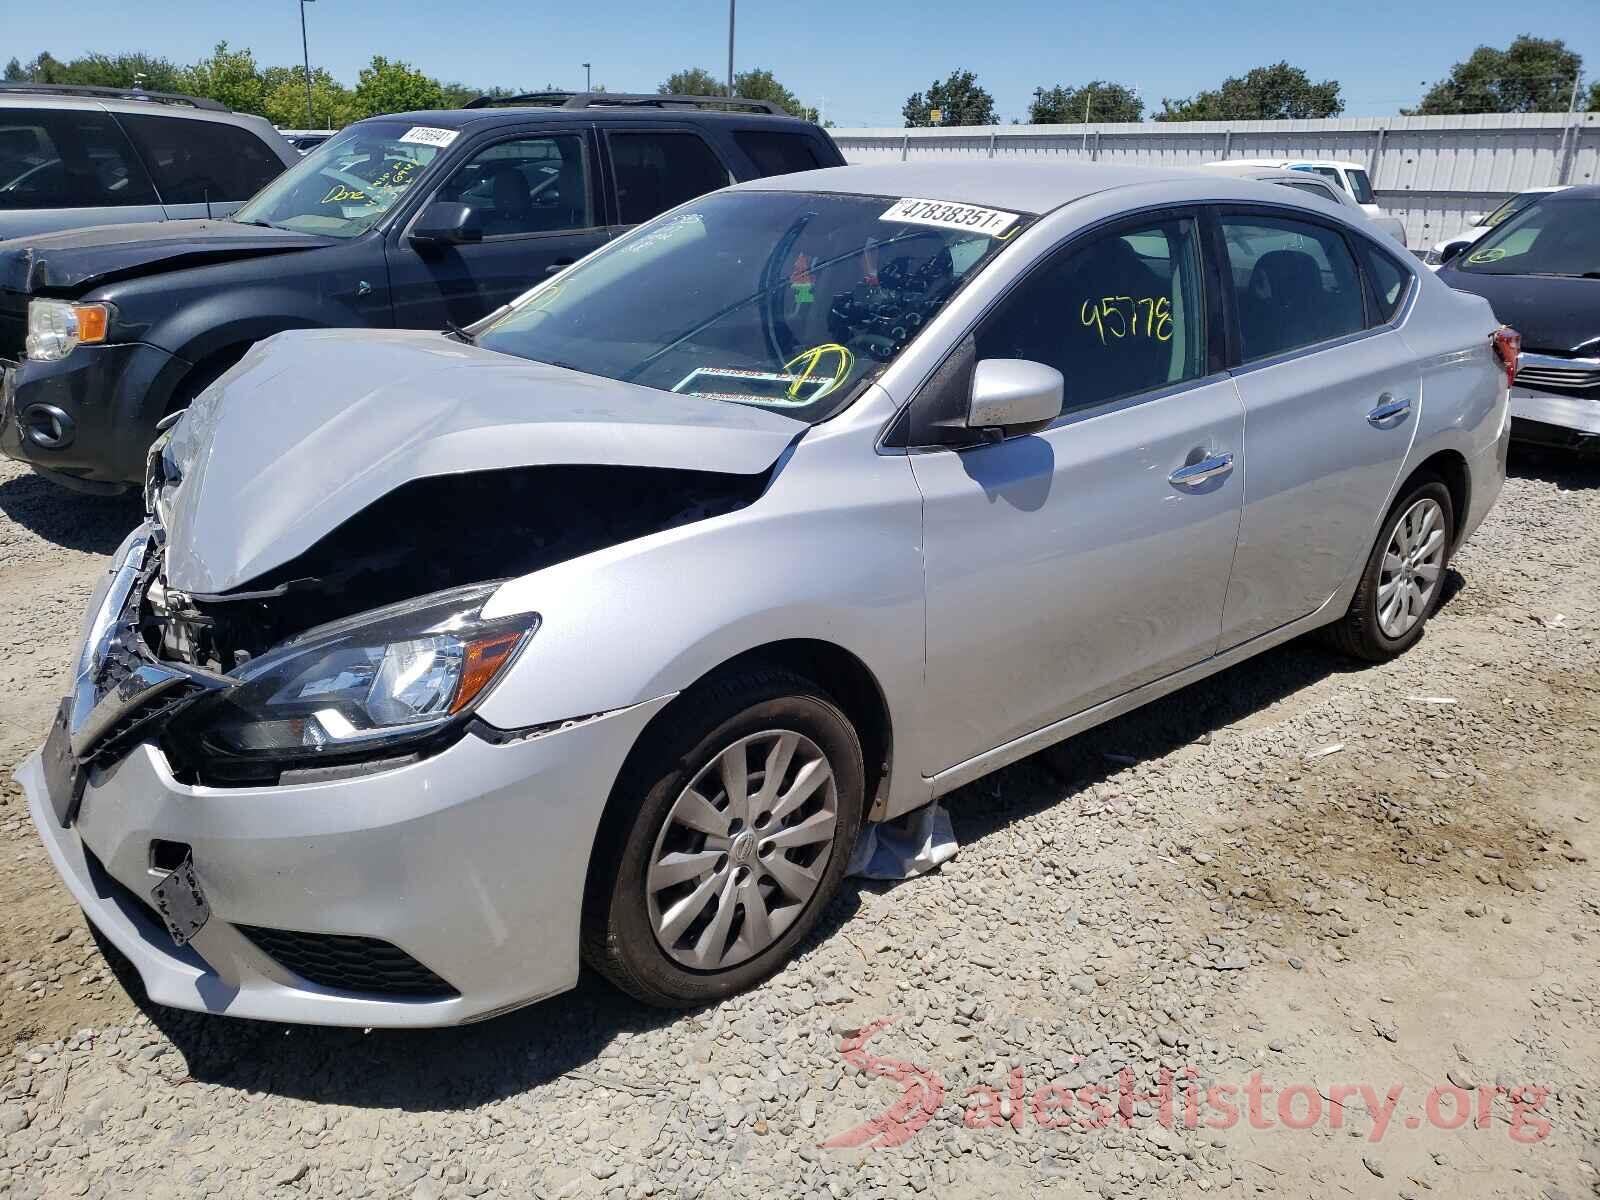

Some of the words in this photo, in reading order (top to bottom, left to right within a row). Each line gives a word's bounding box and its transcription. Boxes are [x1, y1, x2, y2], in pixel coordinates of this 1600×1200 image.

[320, 184, 365, 204] Done
[901, 201, 998, 229] 47838351
[1081, 295, 1174, 346] 95778
